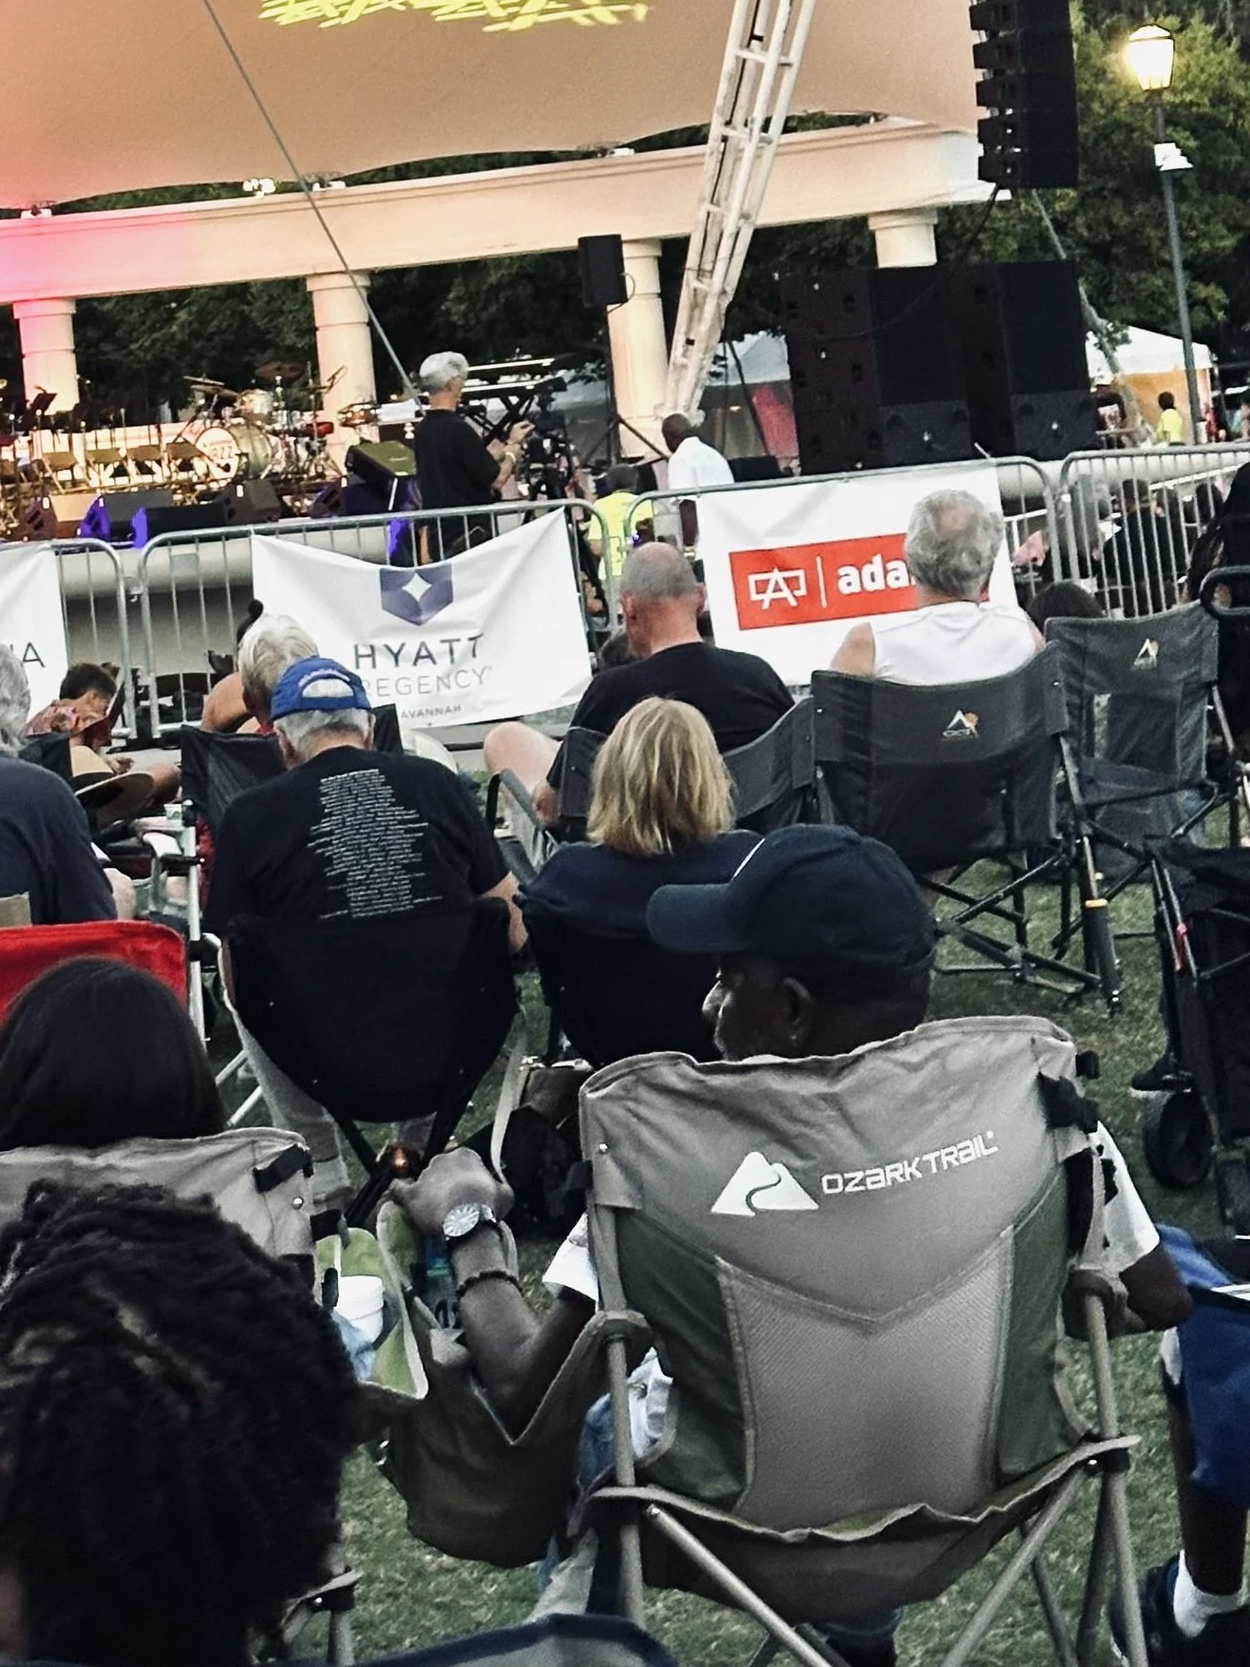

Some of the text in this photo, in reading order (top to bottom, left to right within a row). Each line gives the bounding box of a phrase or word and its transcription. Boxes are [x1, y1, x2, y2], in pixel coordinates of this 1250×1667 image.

[837, 553, 917, 595] ada
[354, 633, 484, 670] HYATT
[400, 704, 462, 719] AVANNAH
